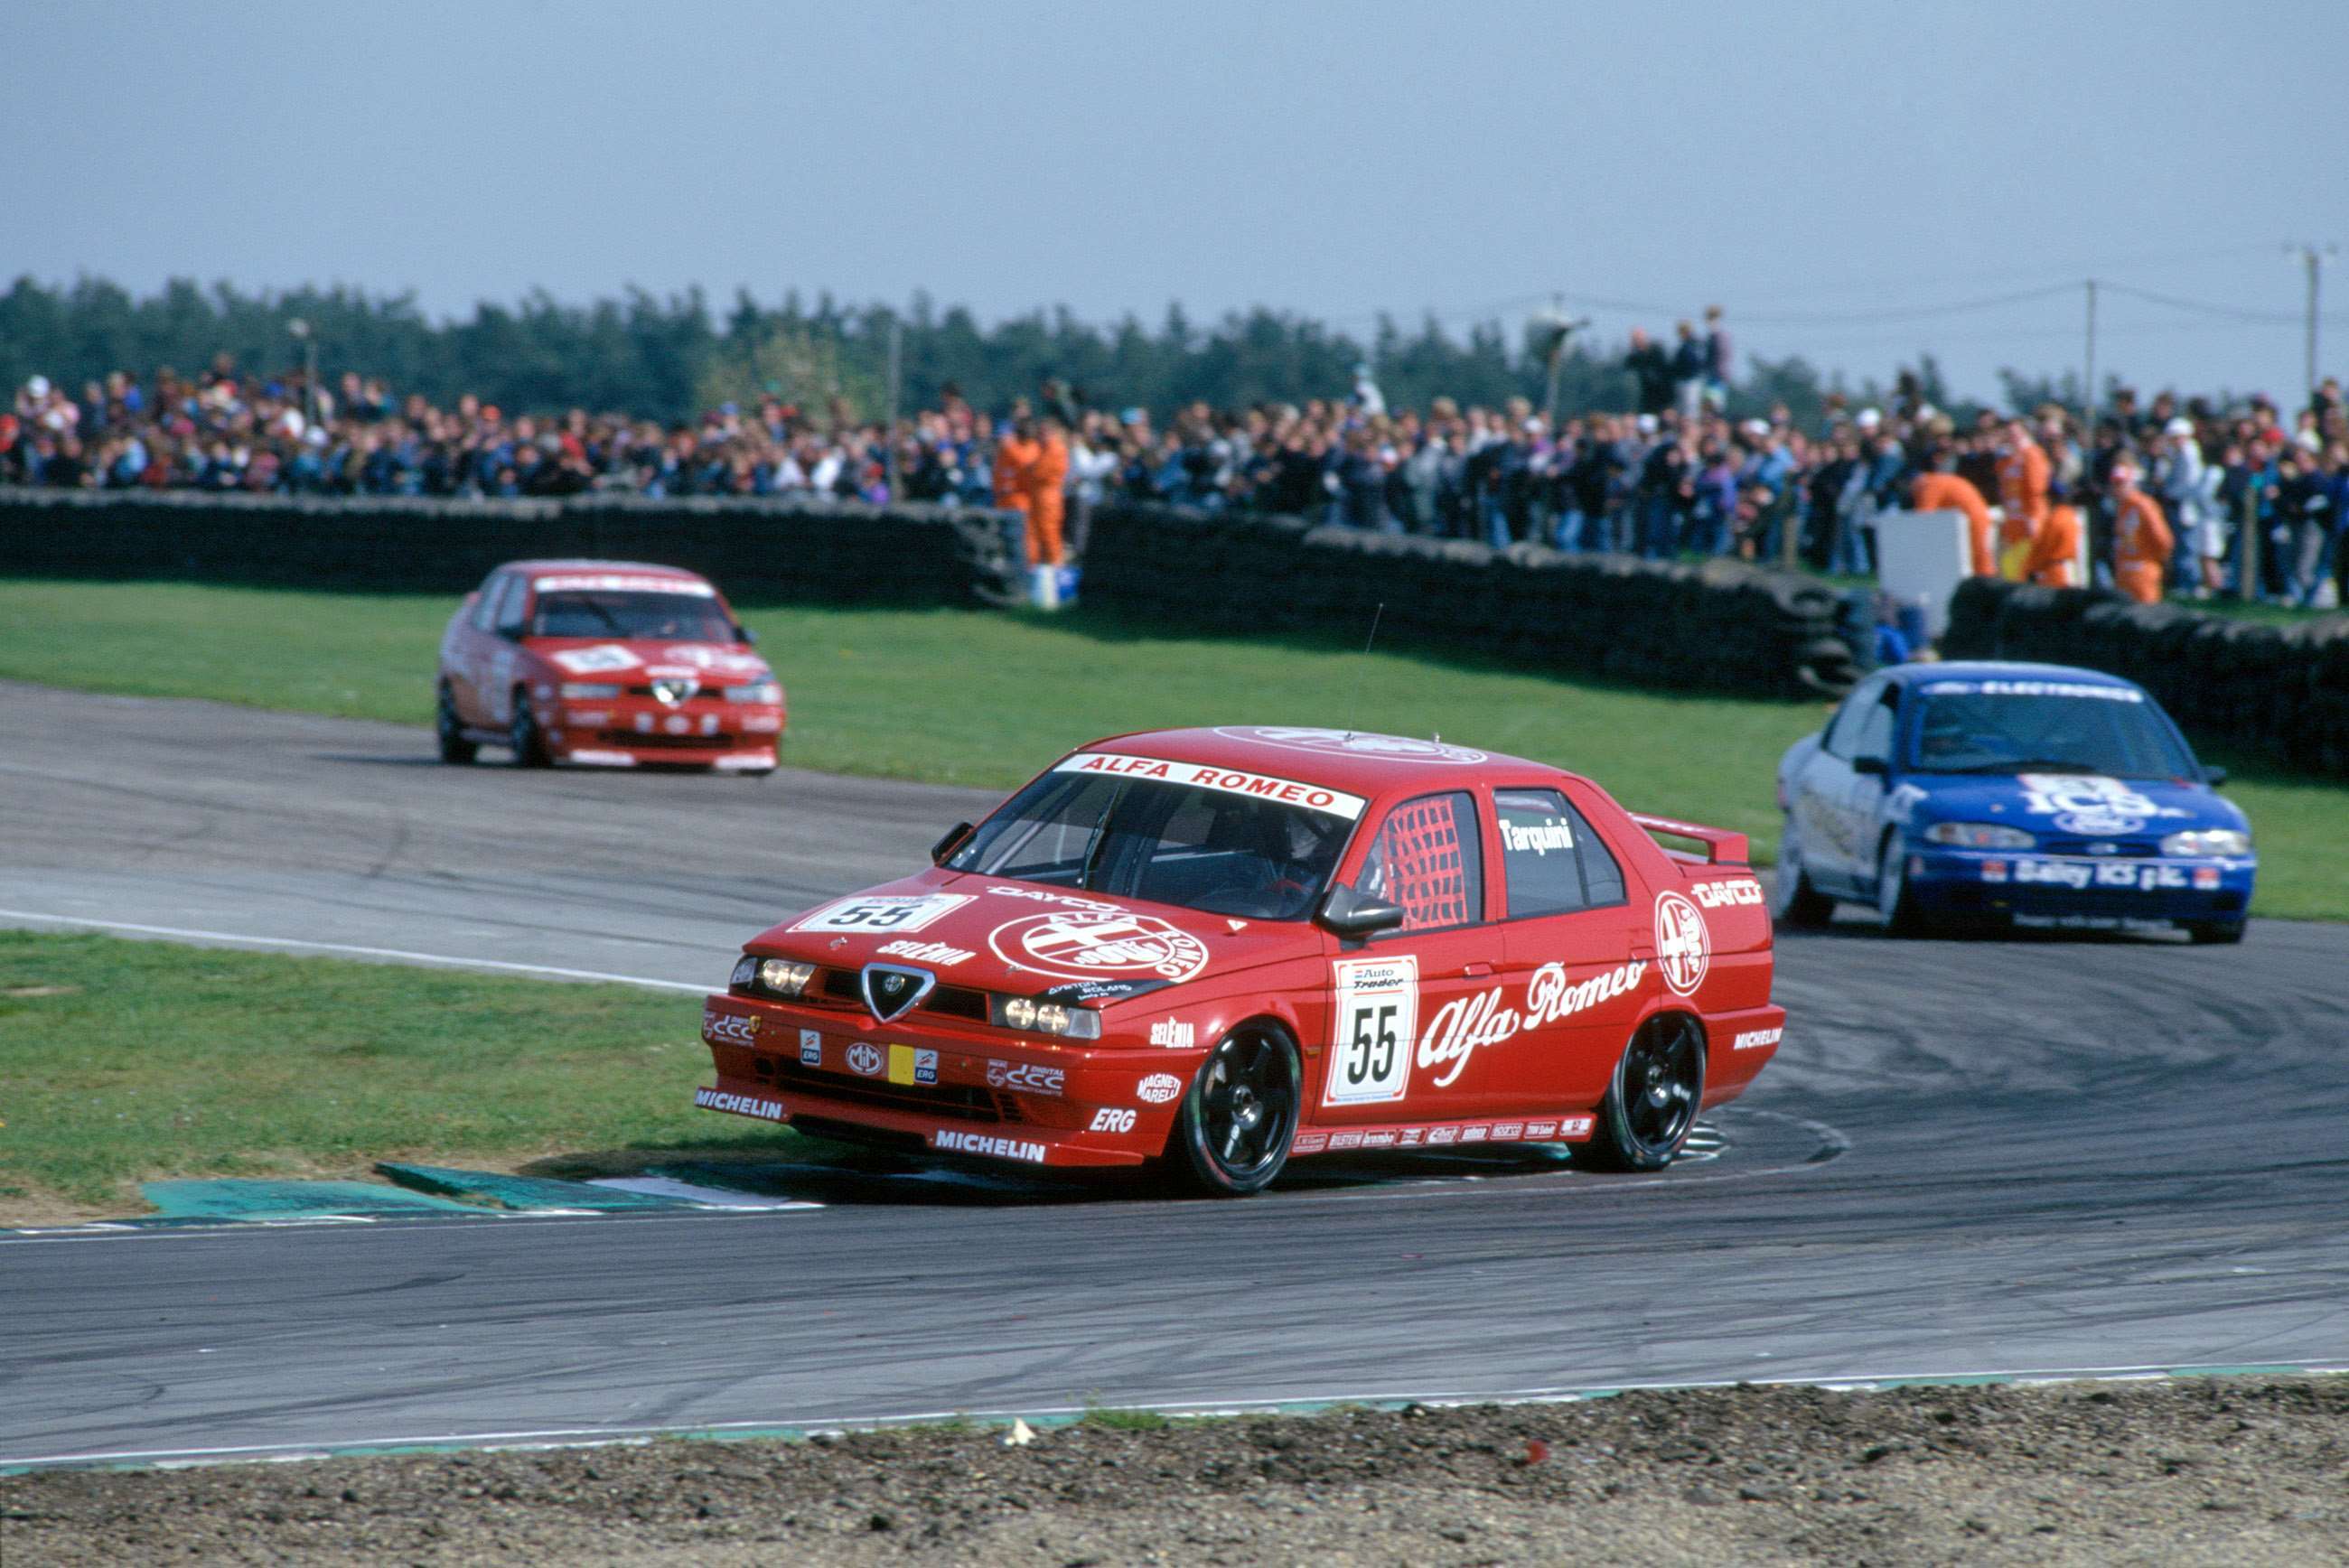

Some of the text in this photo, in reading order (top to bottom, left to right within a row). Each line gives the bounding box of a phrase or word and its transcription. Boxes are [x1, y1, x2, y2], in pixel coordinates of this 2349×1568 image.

[1081, 757, 1334, 807] ALFA ROMEO
[1499, 817, 1574, 855] Tarquini
[986, 885, 1129, 912] DAYCO
[828, 904, 923, 926] 55
[1353, 977, 1404, 989] Trader
[1363, 968, 1395, 978] Auto
[1418, 961, 1648, 1087] Alfa Romeo
[1347, 1004, 1398, 1086] 55
[1733, 1027, 1783, 1050] MICHELIN
[916, 1069, 935, 1079] ERG
[694, 1090, 782, 1120] MICHELIN
[1090, 1107, 1137, 1134] ERG
[935, 1129, 1046, 1162] MICHELIN
